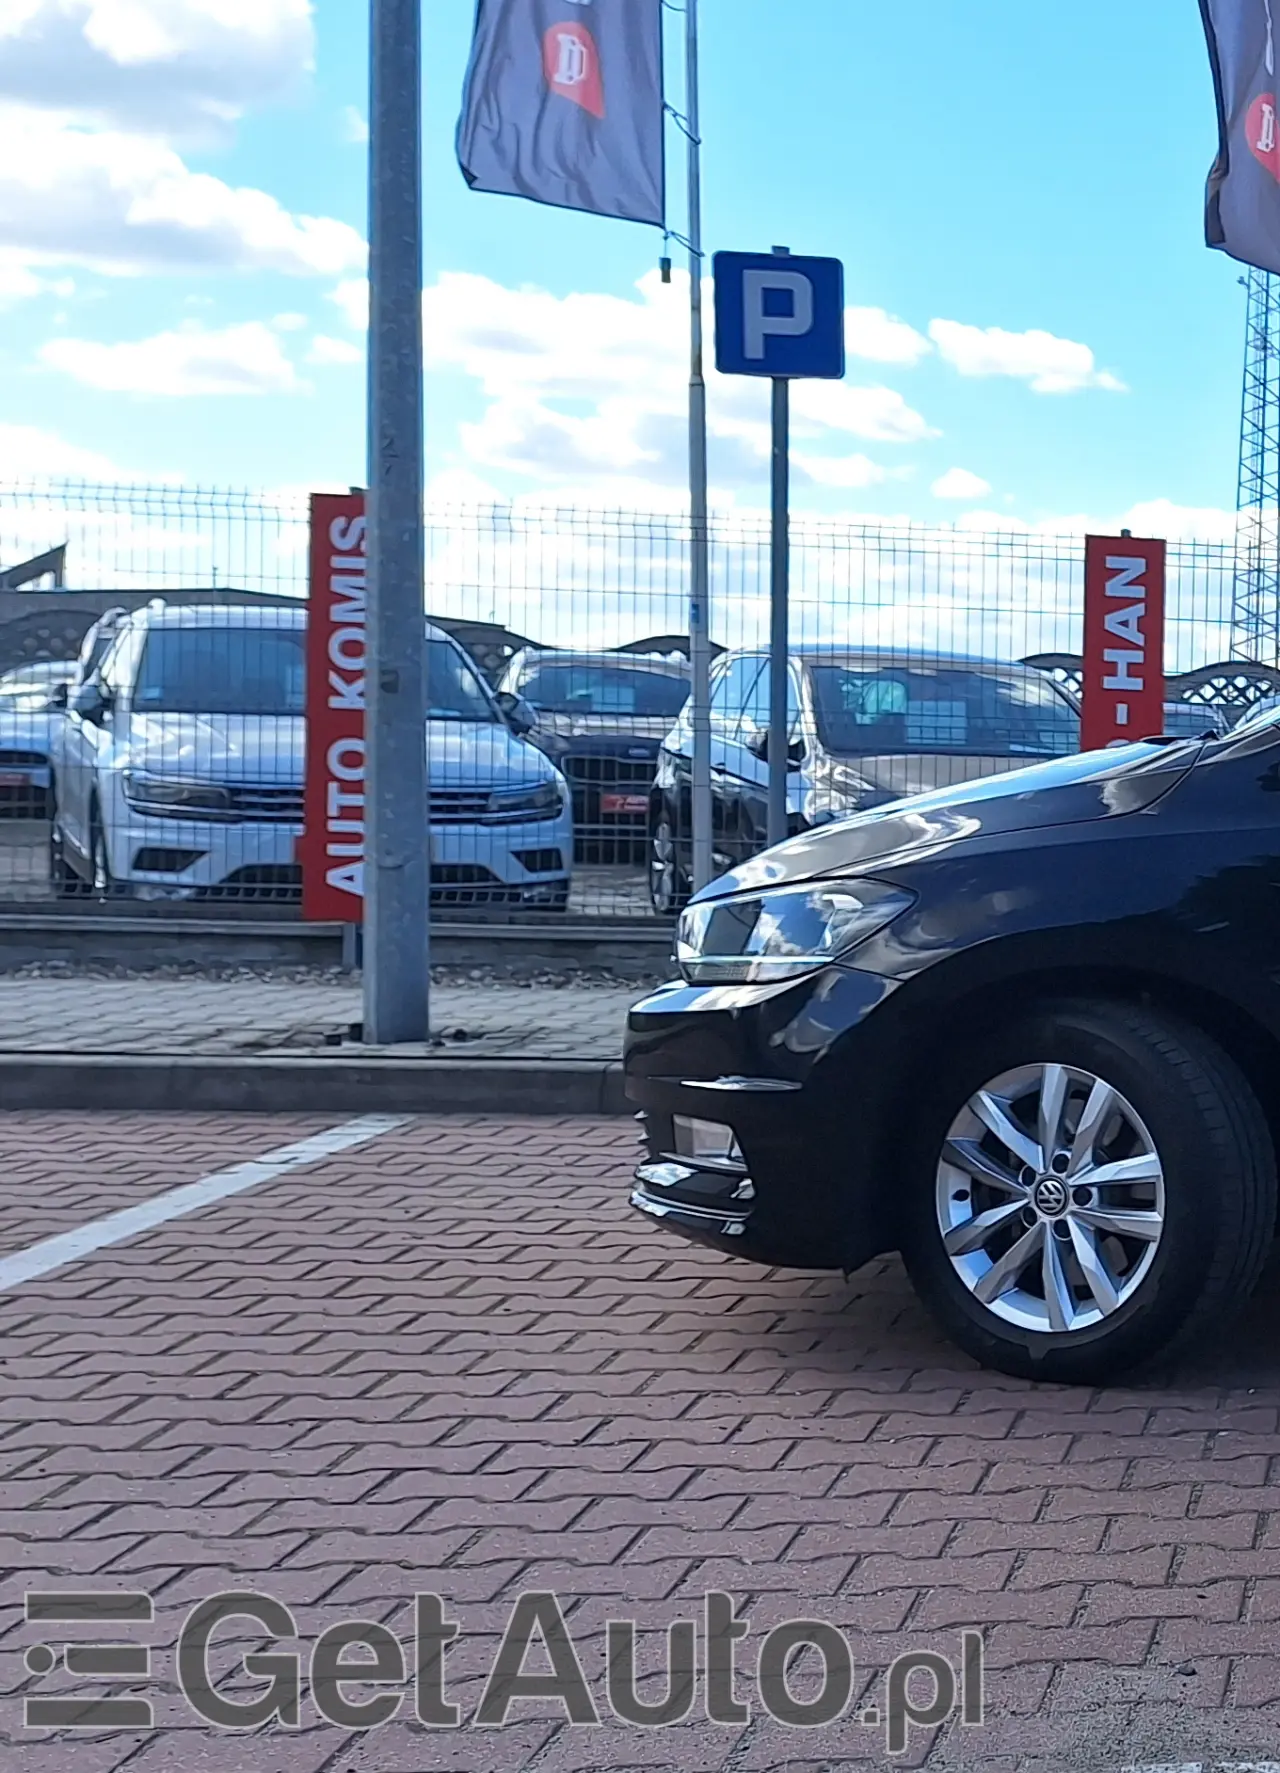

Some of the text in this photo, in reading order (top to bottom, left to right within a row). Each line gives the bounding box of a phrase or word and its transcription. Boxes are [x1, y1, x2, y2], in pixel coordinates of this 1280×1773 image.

[742, 269, 814, 361] P
[1102, 555, 1147, 691] HAN
[326, 514, 368, 898] AUTO KOMIS
